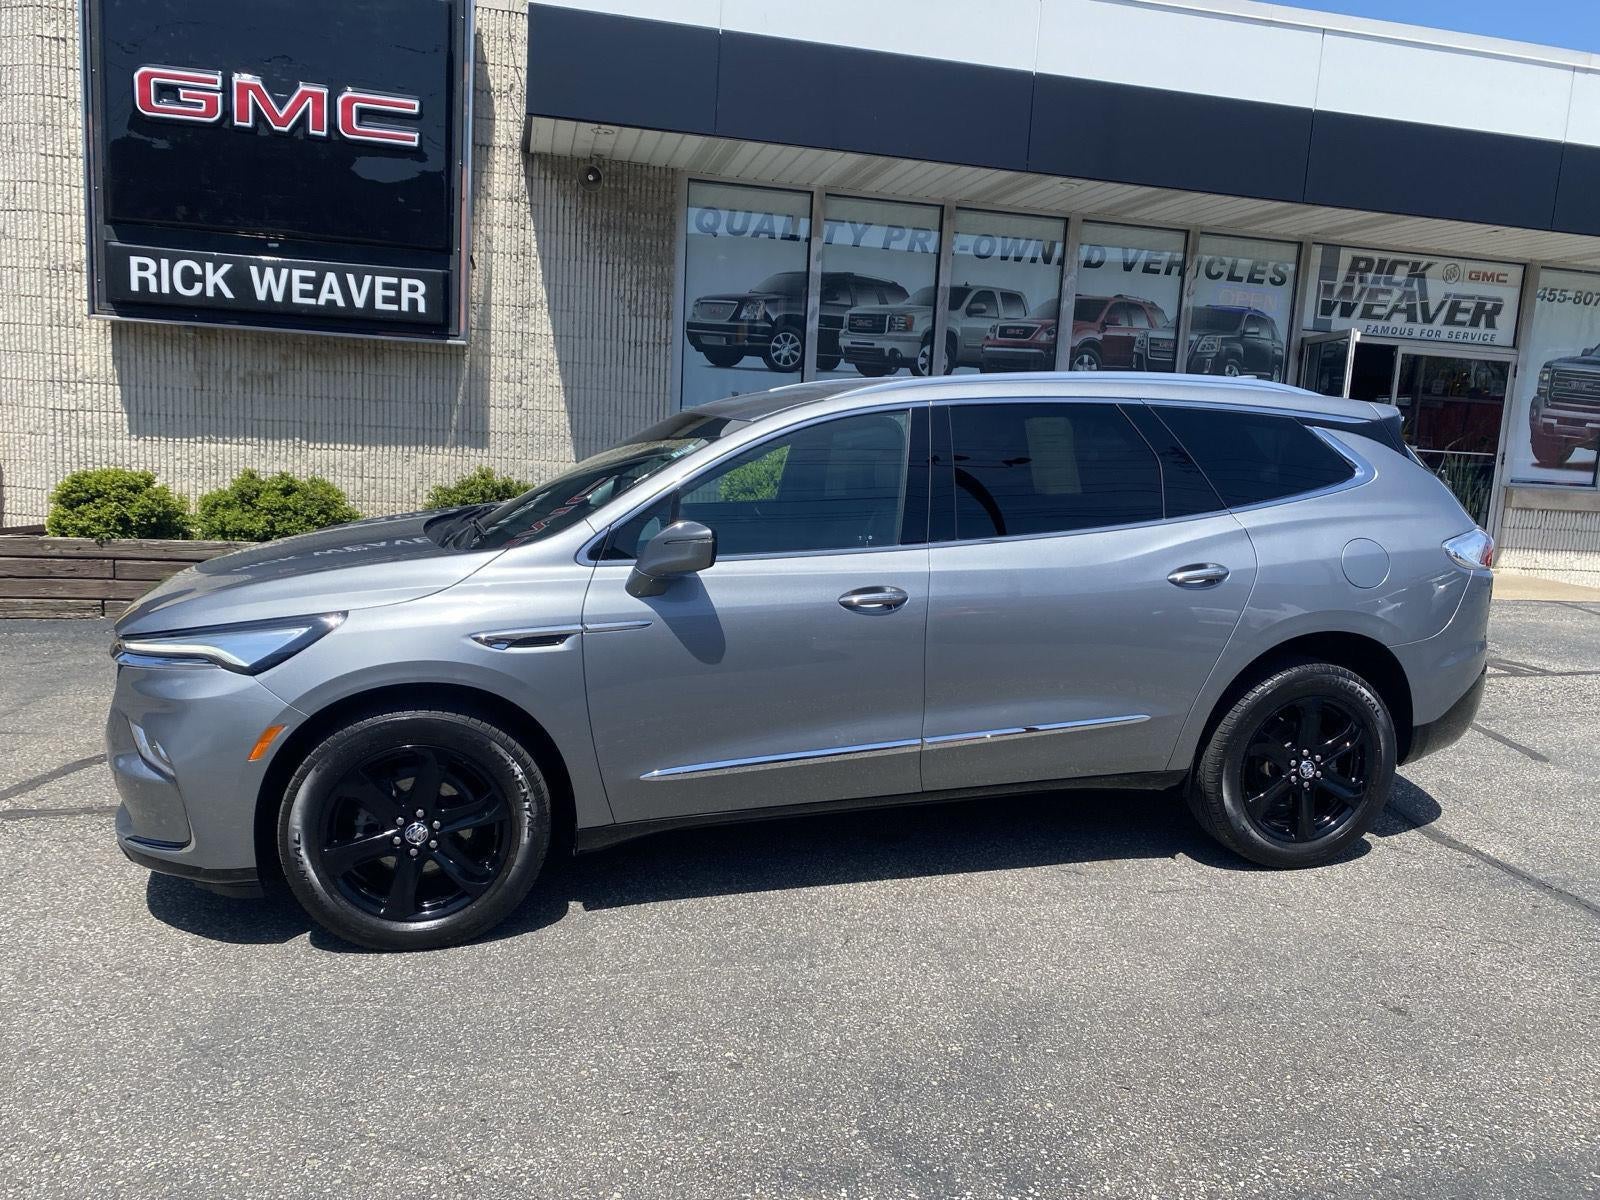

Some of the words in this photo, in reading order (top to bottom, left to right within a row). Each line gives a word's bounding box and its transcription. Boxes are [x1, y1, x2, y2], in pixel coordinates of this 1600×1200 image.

[134, 66, 420, 148] GMC
[880, 225, 1107, 269] PR-OWND
[128, 255, 235, 300] RICK
[249, 265, 427, 314] WEAVER
[1344, 255, 1438, 290] RICK
[1468, 270, 1509, 284] GMC
[1319, 280, 1505, 331] WEAVER
[1364, 323, 1415, 337] FAMOUS
[1419, 327, 1442, 339] FOR
[1447, 330, 1498, 343] SERVICE
